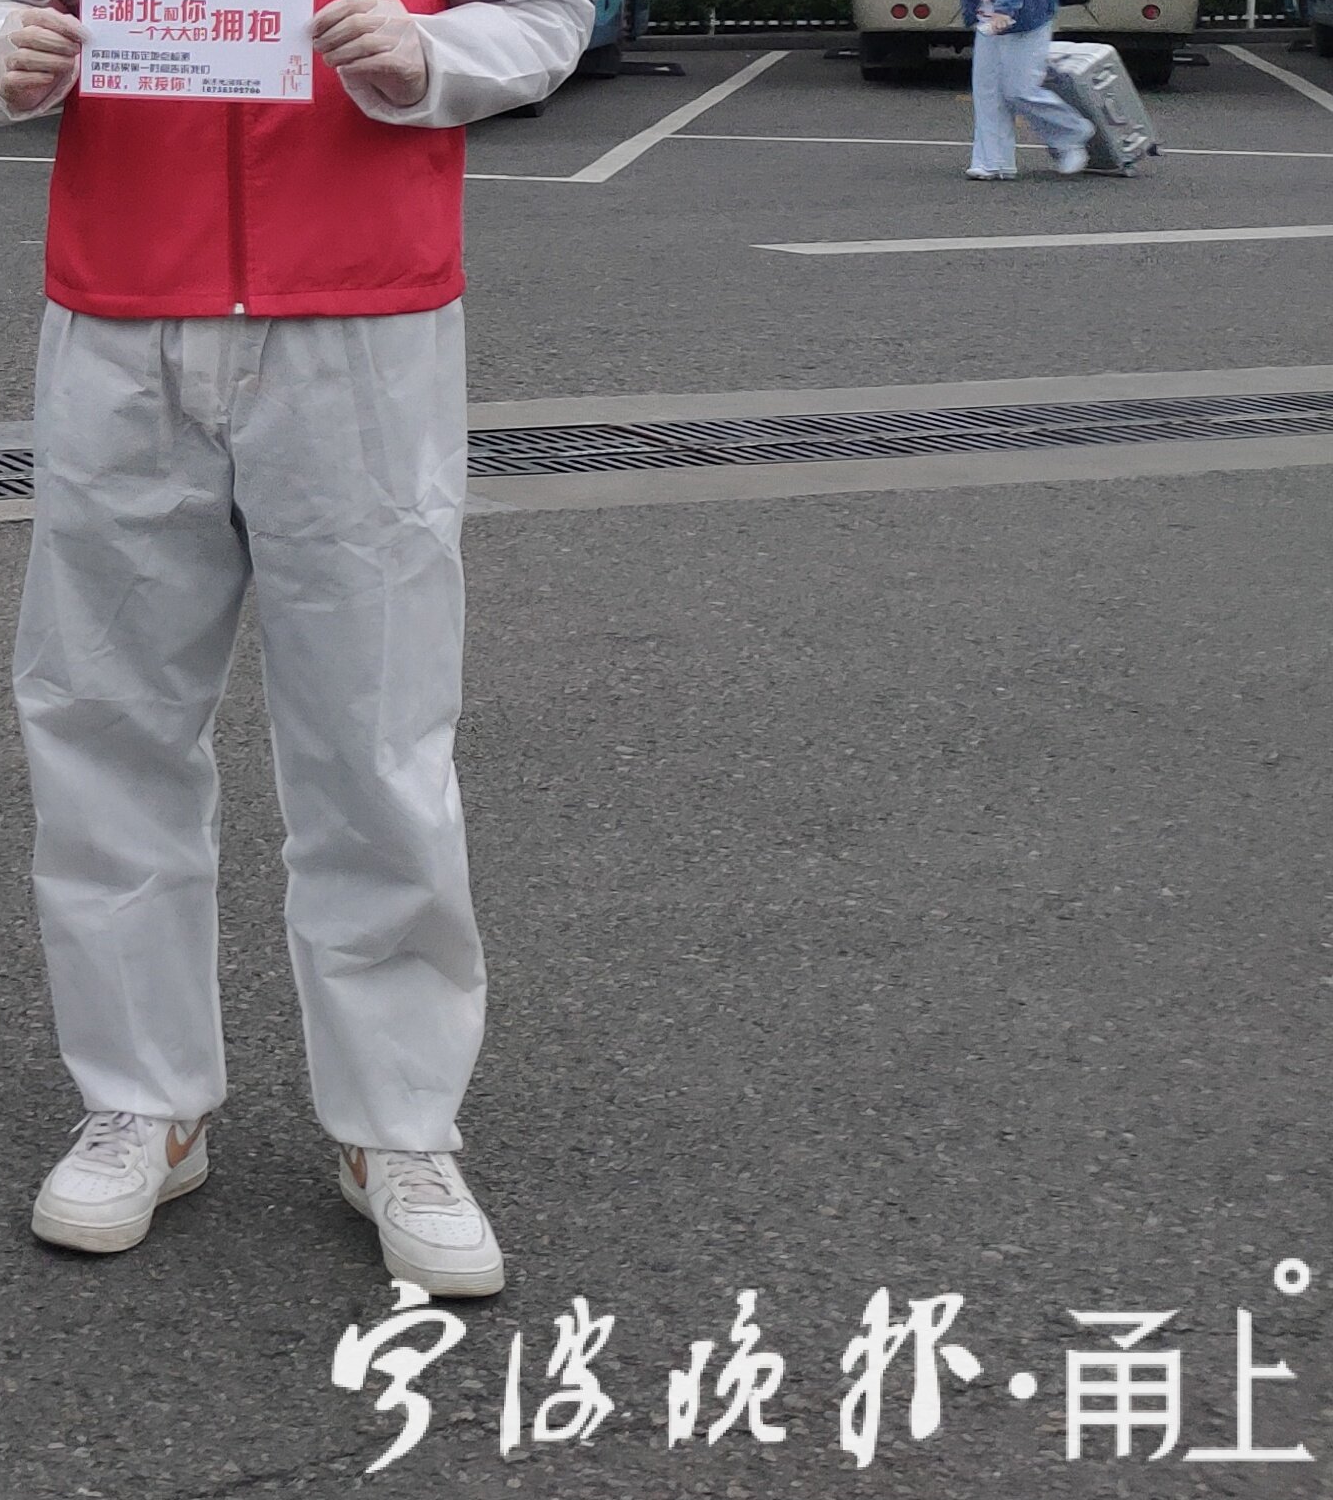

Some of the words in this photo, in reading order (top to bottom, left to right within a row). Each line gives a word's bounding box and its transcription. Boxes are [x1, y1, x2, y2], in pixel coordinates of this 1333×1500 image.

[128, 9, 281, 42] 一个大大的拥抱
